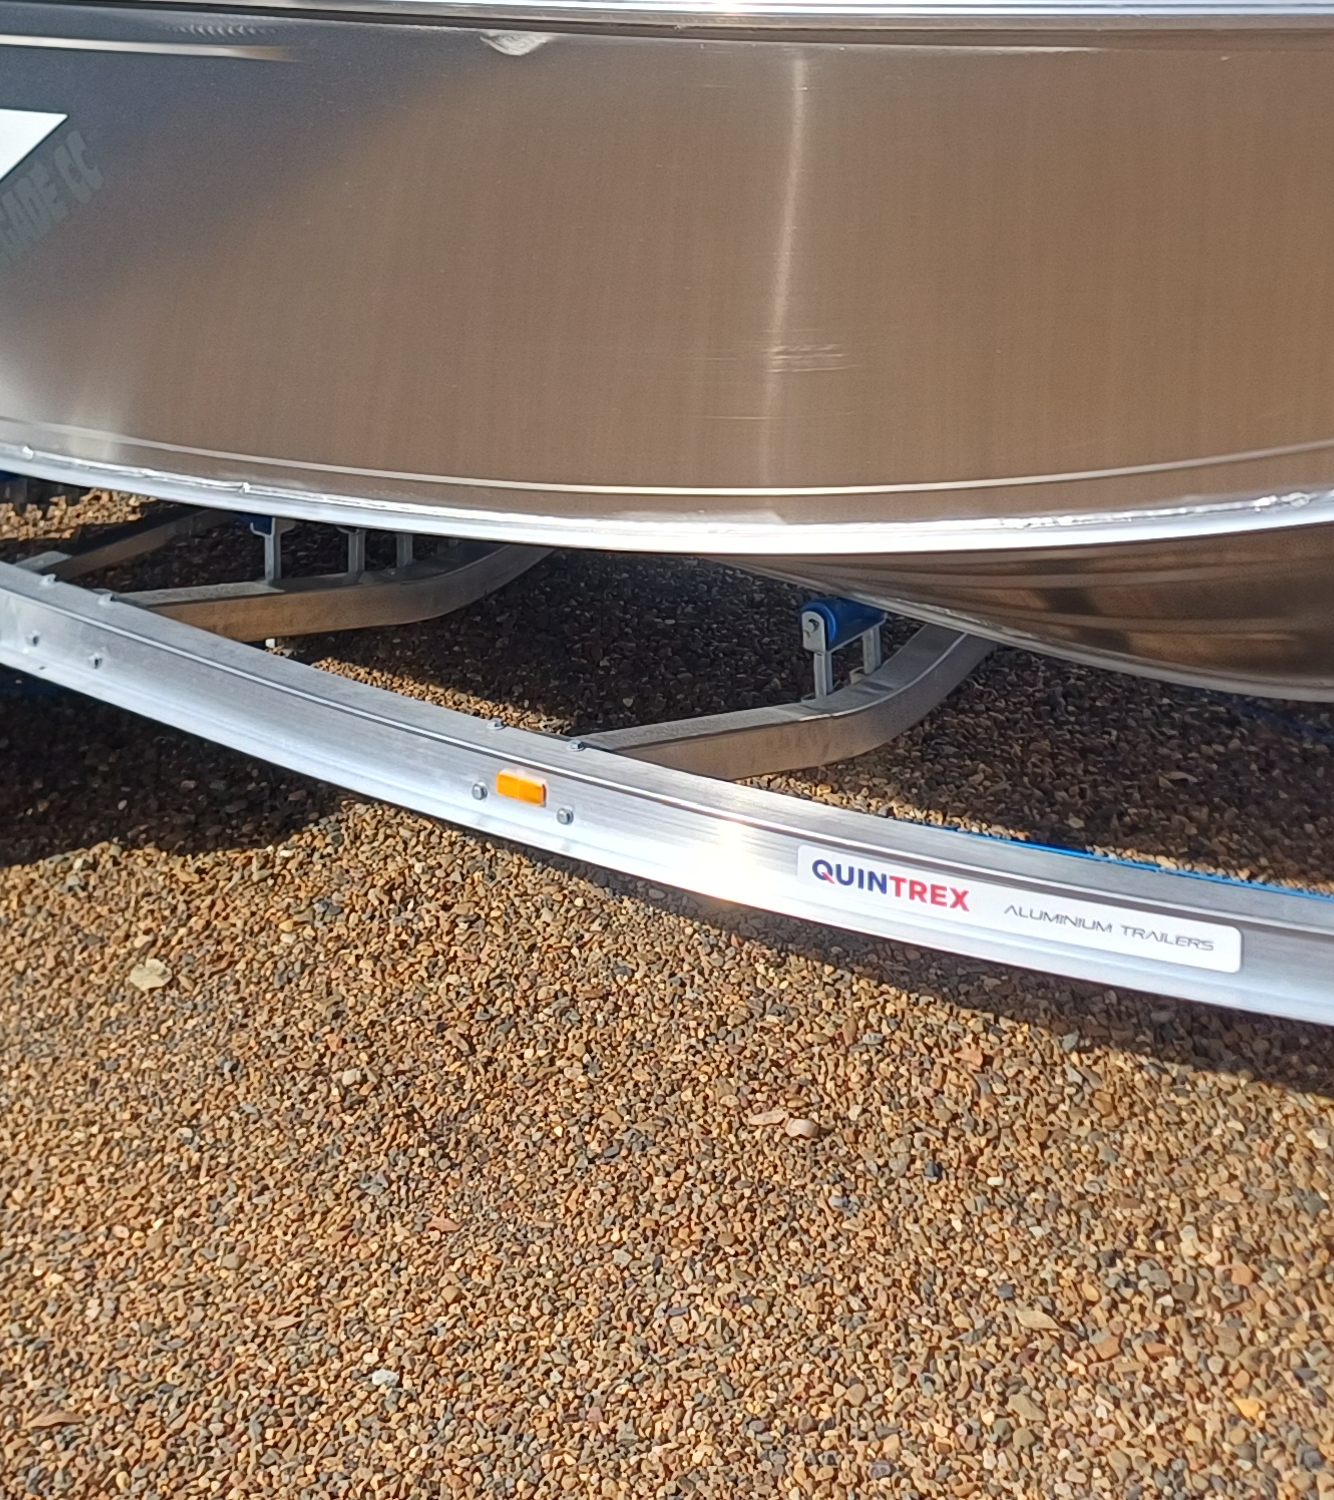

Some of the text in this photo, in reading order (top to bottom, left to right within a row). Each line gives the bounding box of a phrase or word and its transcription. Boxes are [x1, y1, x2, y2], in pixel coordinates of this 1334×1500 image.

[53, 130, 104, 204] CC
[811, 859, 1215, 951] QUINTREX ALUMINIUM TRAILERS
